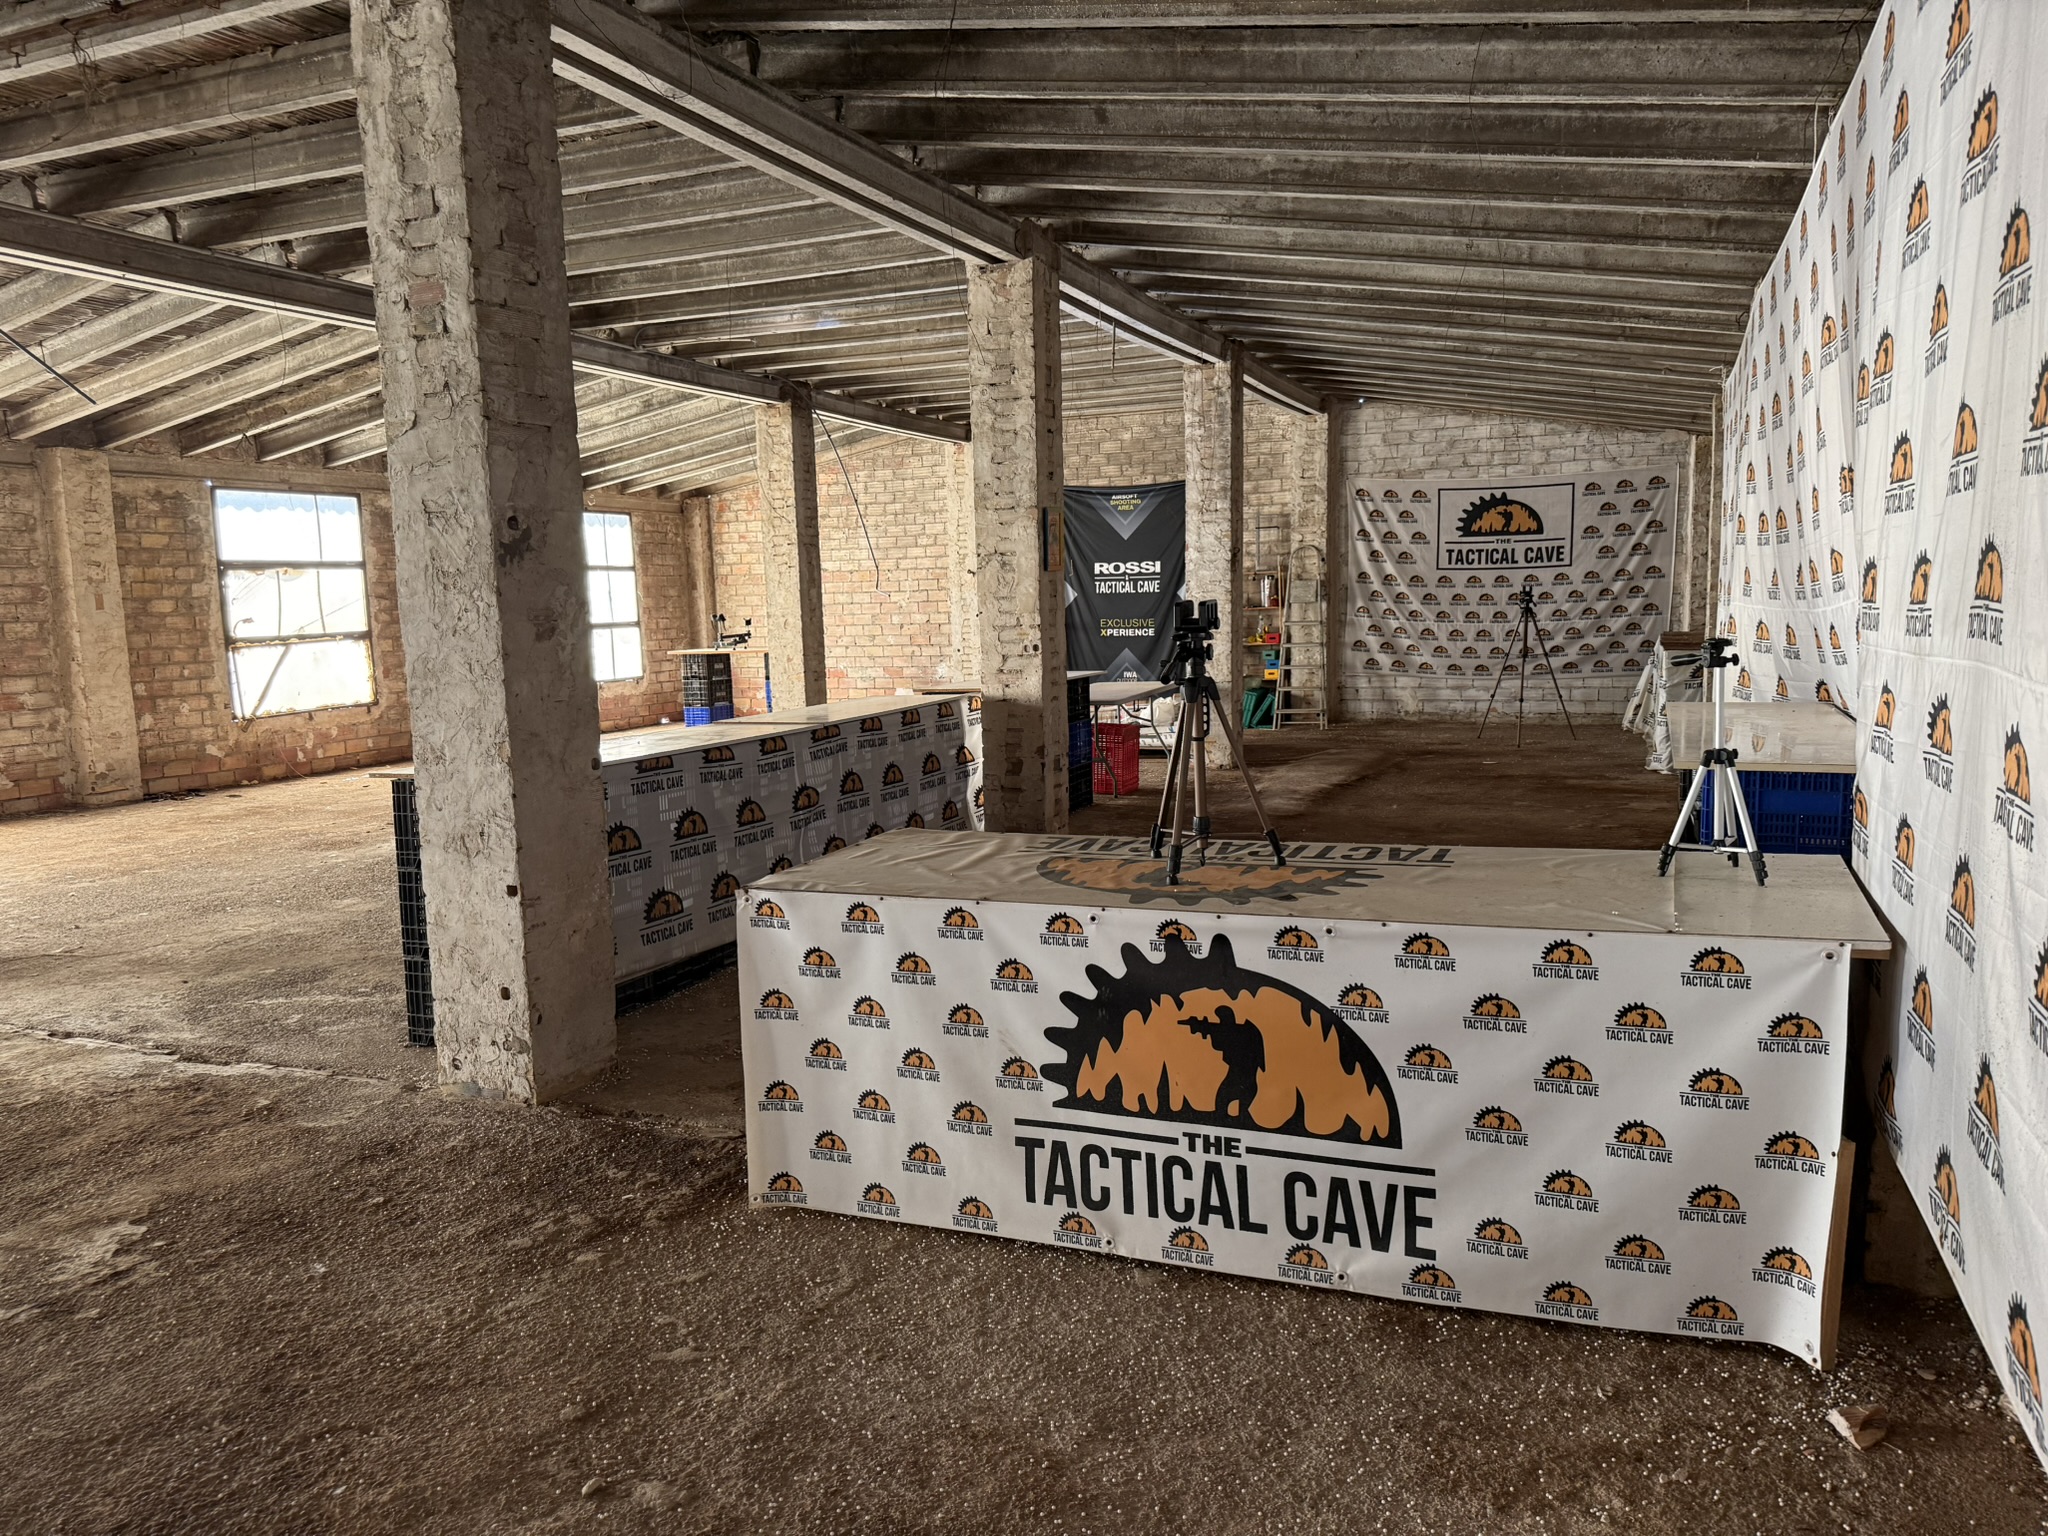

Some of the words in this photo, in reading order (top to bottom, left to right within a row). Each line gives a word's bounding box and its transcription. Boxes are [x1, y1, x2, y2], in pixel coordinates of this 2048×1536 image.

[1963, 463, 1978, 492] CAV
[1446, 548, 1518, 565] TACTICAL
[1524, 546, 1565, 563] CAVE
[1094, 561, 1161, 574] ROSSI
[1095, 581, 1136, 594] TACTICAL
[1138, 580, 1160, 593] CAVE
[1100, 619, 1155, 628] EXCLUSIVE
[1100, 628, 1155, 636] XPERIENCE
[757, 761, 780, 775] TACTICAL
[782, 757, 795, 770] CAVE
[700, 770, 726, 784] TACTICAL
[728, 768, 743, 780] CAVE
[631, 779, 665, 796] TACTICAL
[667, 775, 683, 790] CAVE
[734, 832, 759, 848] TACTICAL
[760, 827, 774, 841] CAVE
[2016, 814, 2034, 853] CAVE
[671, 845, 700, 862] TACTICAL
[702, 840, 717, 855] CAVE
[634, 856, 652, 872] CAVE
[708, 906, 734, 924] TACTICAL
[641, 926, 676, 946] TACTICAL
[678, 919, 693, 934] CAVE
[750, 919, 775, 930] TACTICAL
[775, 920, 790, 930] CAVE
[841, 924, 868, 934] TACTICAL
[868, 925, 885, 935] CAVE
[937, 929, 966, 940] TACTICAL
[966, 930, 984, 941] CAVE
[1039, 935, 1070, 947] TACTICAL
[1070, 937, 1089, 948] CAVE
[1267, 949, 1302, 962] TACTICAL
[1303, 951, 1324, 963] CAVE
[1394, 957, 1432, 971] TACTICAL
[1433, 959, 1456, 972] CAVE
[798, 968, 825, 978] TACTICAL
[825, 969, 841, 979] CAVE
[891, 974, 919, 985] TACTICAL
[919, 975, 936, 986] CAVE
[1532, 966, 1573, 980] TACTICAL
[1574, 968, 1599, 981] CAVE
[990, 981, 1020, 993] TACTICAL
[1020, 983, 1039, 994] CAVE
[1680, 974, 1724, 989] TACTICAL
[1725, 977, 1752, 990] CAVE
[754, 1011, 782, 1021] TACTICAL
[782, 1011, 799, 1021] CAVE
[848, 1016, 874, 1028] TACTICAL
[874, 1018, 890, 1030] CAVE
[1367, 1011, 1390, 1024] CAVE
[942, 1025, 971, 1037] TACTICAL
[971, 1027, 989, 1039] CAVE
[1463, 1019, 1502, 1032] TACTICAL
[1503, 1021, 1527, 1034] CAVE
[1605, 1029, 1647, 1043] TACTICAL
[1648, 1031, 1674, 1045] CAVE
[1757, 1041, 1802, 1054] TACTICAL
[1803, 1043, 1830, 1056] CAVE
[804, 1059, 831, 1071] TACTICAL
[831, 1061, 847, 1072] CAVE
[896, 1069, 923, 1081] TACTICAL
[924, 1071, 940, 1083] CAVE
[1397, 1068, 1435, 1083] TACTICAL
[1435, 1071, 1459, 1084] CAVE
[995, 1079, 1025, 1091] TACTICAL
[1025, 1081, 1044, 1092] CAVE
[1533, 1081, 1574, 1095] TACTICAL
[1575, 1083, 1599, 1097] CAVE
[758, 1102, 786, 1112] TACTICAL
[786, 1102, 804, 1113] CAVE
[1679, 1094, 1722, 1109] TACTICAL
[1723, 1097, 1750, 1110] CAVE
[852, 1110, 879, 1122] TACTICAL
[879, 1112, 896, 1124] CAVE
[947, 1122, 975, 1135] TACTICAL
[975, 1124, 992, 1136] CAVE
[1183, 1132, 1241, 1158] THE
[1465, 1131, 1504, 1145] TACTICAL
[1505, 1133, 1529, 1147] CAVE
[809, 1150, 836, 1163] TACTICAL
[836, 1153, 852, 1164] CAVE
[1605, 1145, 1646, 1161] TACTICAL
[1647, 1149, 1673, 1163] CAVE
[902, 1163, 929, 1176] TACTICAL
[929, 1165, 946, 1177] CAVE
[1754, 1157, 1798, 1175] TACTICAL
[1799, 1162, 1826, 1177] CAVE
[762, 1193, 790, 1204] TACTICAL
[790, 1194, 808, 1205] CAVE
[1015, 1137, 1268, 1234] TACTICAL
[1284, 1171, 1436, 1261] CAVE
[1534, 1194, 1574, 1211] TACTICAL
[1575, 1198, 1599, 1213] CAVE
[857, 1203, 883, 1216] TACTICAL
[884, 1205, 900, 1218] CAVE
[1678, 1210, 1720, 1224] TACTICAL
[1721, 1212, 1747, 1225] CAVE
[952, 1217, 980, 1231] TACTICAL
[981, 1220, 998, 1233] CAVE
[1053, 1232, 1083, 1246] TACTICAL
[1083, 1235, 1102, 1248] CAVE
[1161, 1247, 1193, 1264] TACTICAL
[1194, 1252, 1214, 1267] CAVE
[1466, 1241, 1505, 1258] TACTICAL
[1505, 1244, 1529, 1260] CAVE
[1605, 1259, 1646, 1274] TACTICAL
[1647, 1262, 1672, 1275] CAVE
[1278, 1266, 1312, 1283] TACTICAL
[1312, 1271, 1333, 1285] CAVE
[1752, 1271, 1791, 1292] TACTICAL
[1792, 1279, 1816, 1298] CAVE
[1401, 1283, 1438, 1300] TACTICAL
[1439, 1288, 1462, 1303] CAVE
[1535, 1303, 1574, 1319] TACTICAL
[1575, 1306, 1599, 1321] CAVE
[1677, 1319, 1718, 1334] TACTICAL
[1719, 1322, 1745, 1336] CAVE
